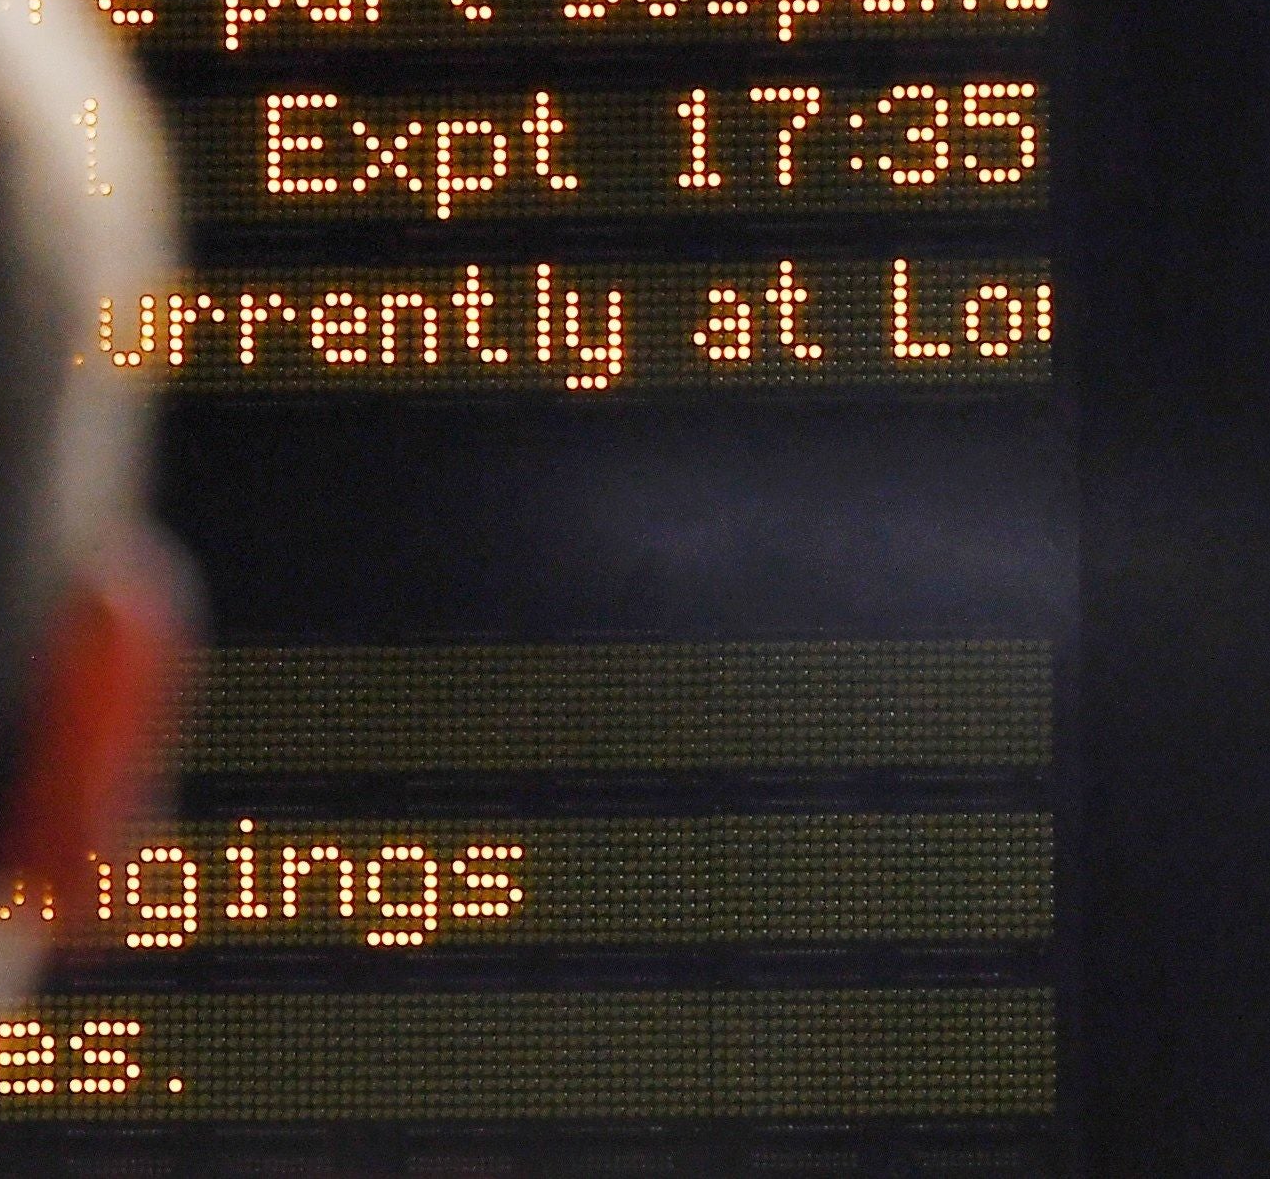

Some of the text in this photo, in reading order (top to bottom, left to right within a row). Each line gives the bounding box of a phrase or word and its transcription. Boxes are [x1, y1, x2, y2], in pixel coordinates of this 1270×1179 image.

[266, 91, 580, 222] Expt
[677, 83, 1037, 188] 17:35
[73, 262, 625, 392] urrently
[693, 260, 824, 362] at
